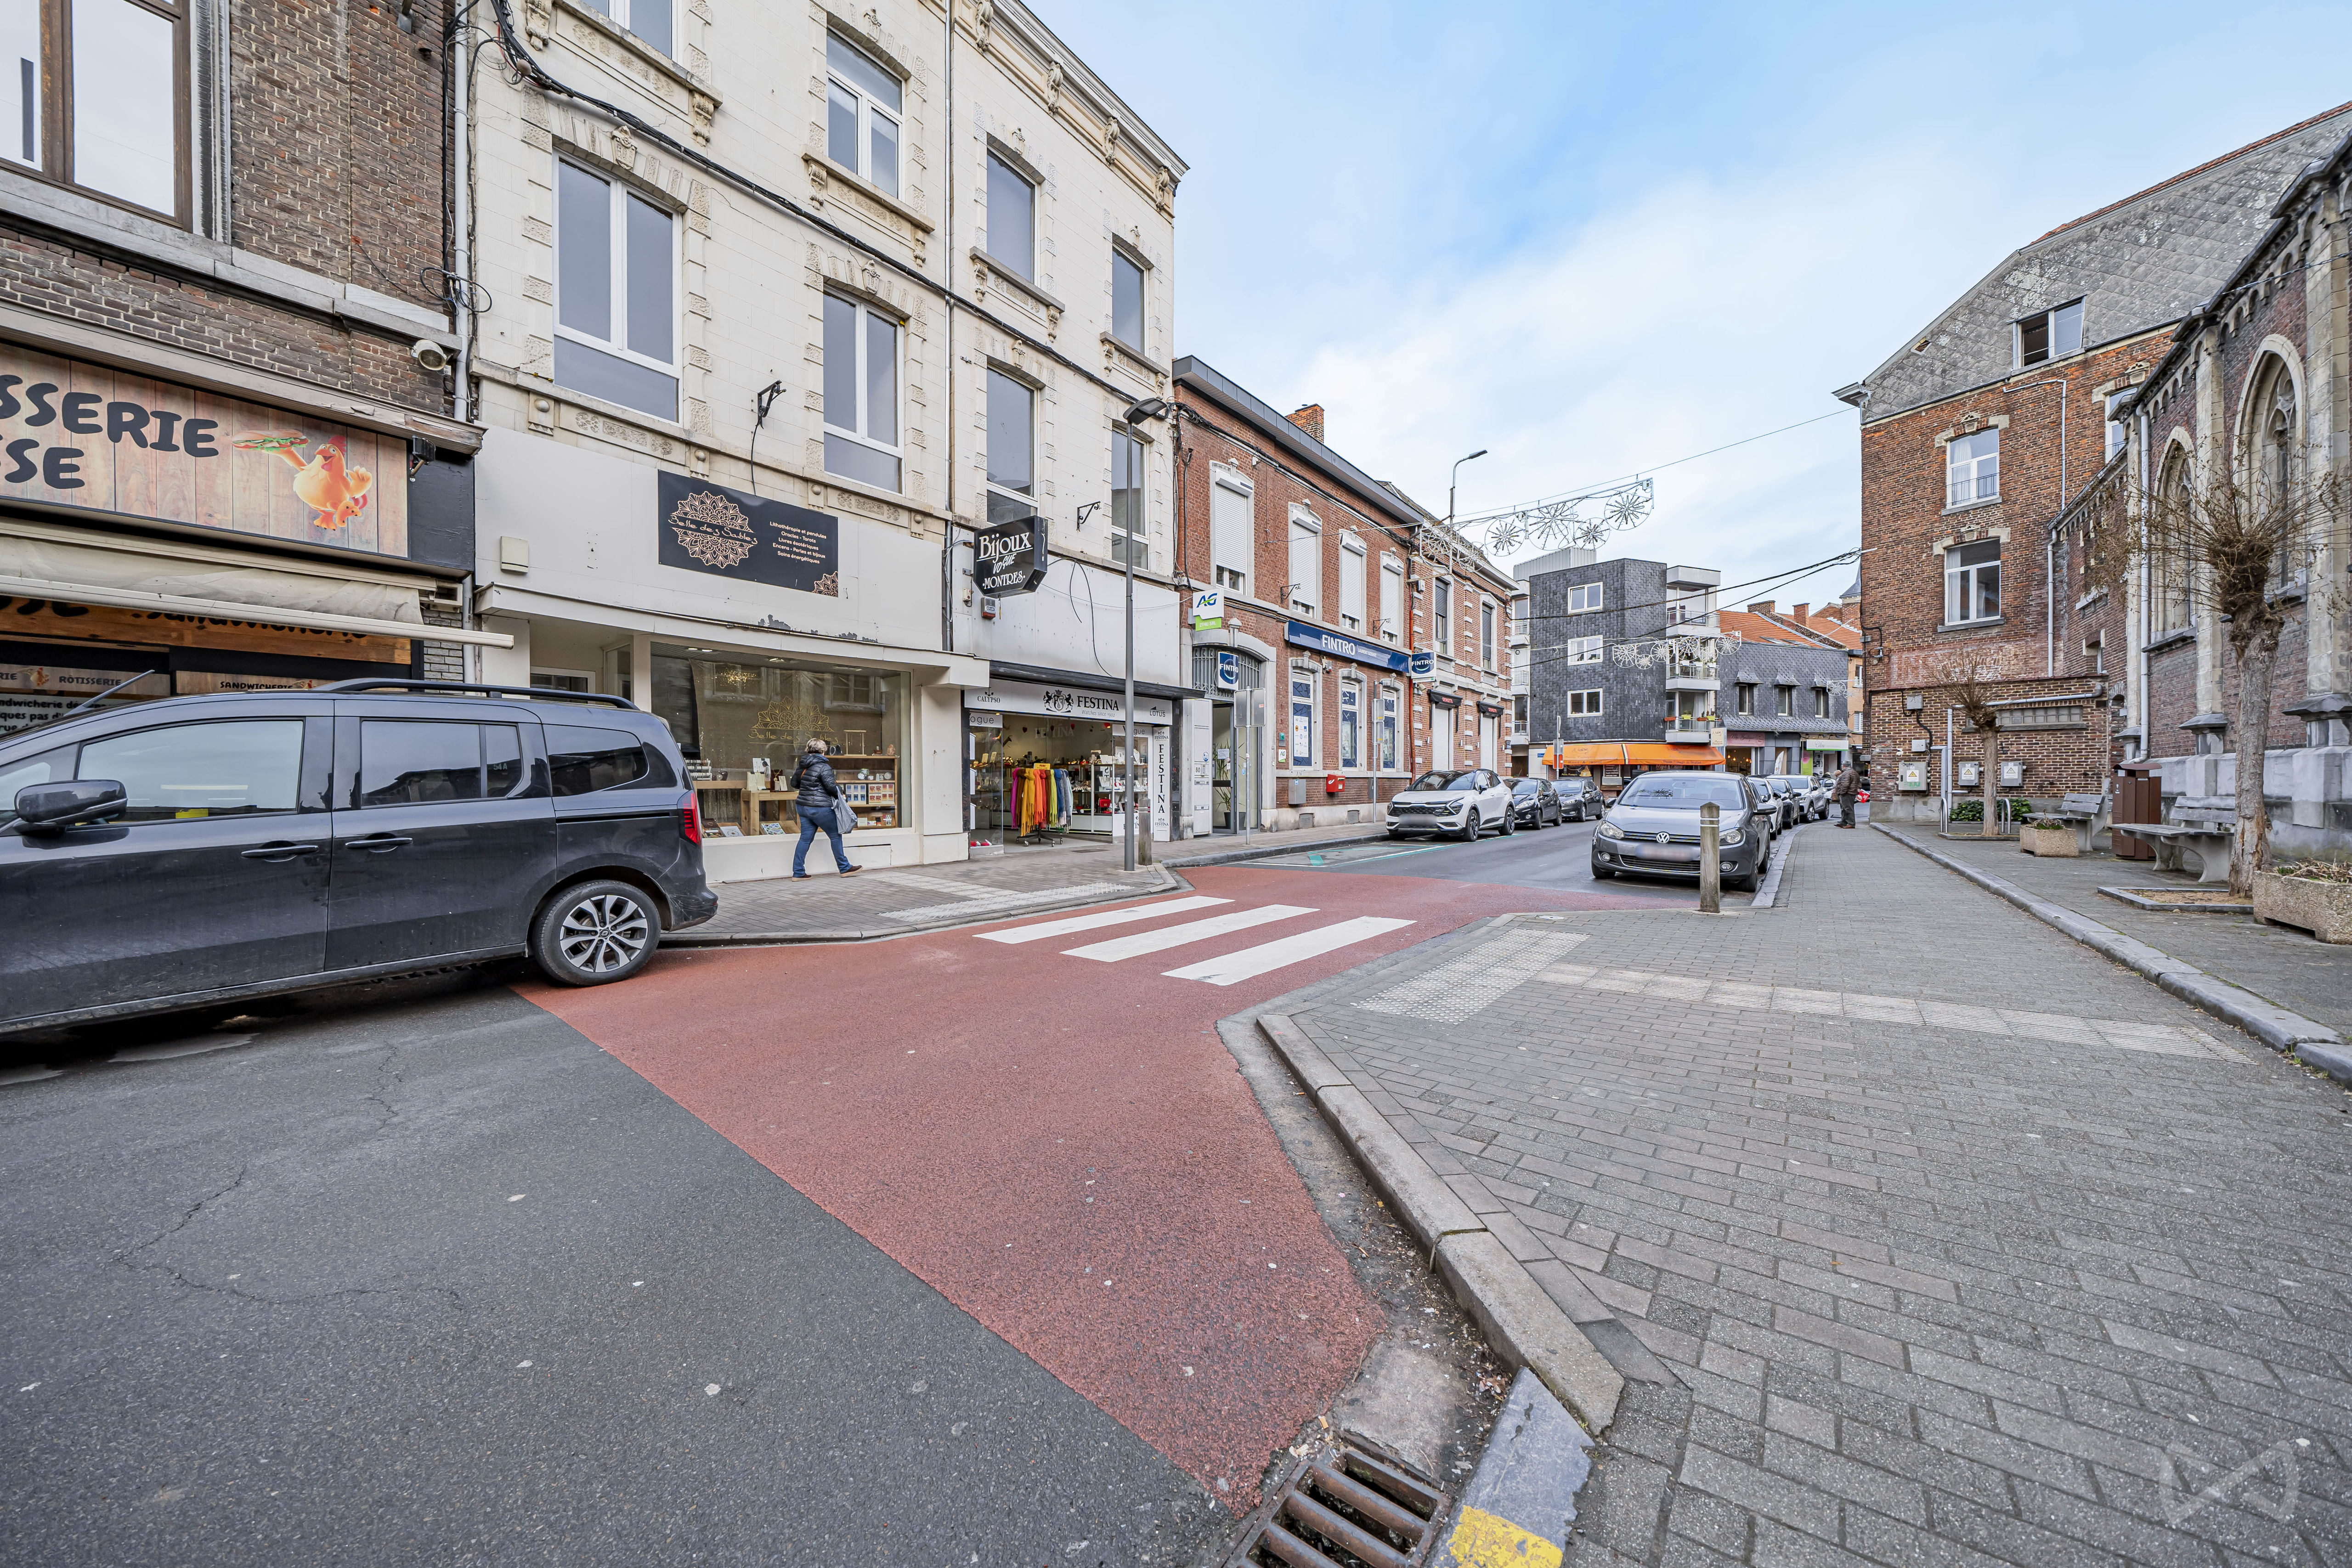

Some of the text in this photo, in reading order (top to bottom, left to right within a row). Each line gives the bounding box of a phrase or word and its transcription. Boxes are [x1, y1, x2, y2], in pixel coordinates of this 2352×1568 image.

[0, 433, 85, 489] SE
[668, 515, 758, 545] Belle des Sables
[770, 521, 800, 532] Lithothérapie
[793, 541, 819, 550] ésotériques
[979, 532, 1032, 563] Bijoux
[791, 554, 820, 564] énergétiques
[993, 553, 1017, 574] VOGUE
[1196, 592, 1217, 608] AG
[1322, 634, 1355, 655] FINTRO
[1220, 664, 1239, 673] FINTRO
[59, 675, 122, 686] RÔTISSERIE
[1077, 695, 1119, 711] FESTINA
[30, 713, 49, 723] pas
[970, 713, 994, 725] ogue
[748, 729, 838, 744] Belle des Sbles
[1157, 744, 1165, 813] FESTINA
